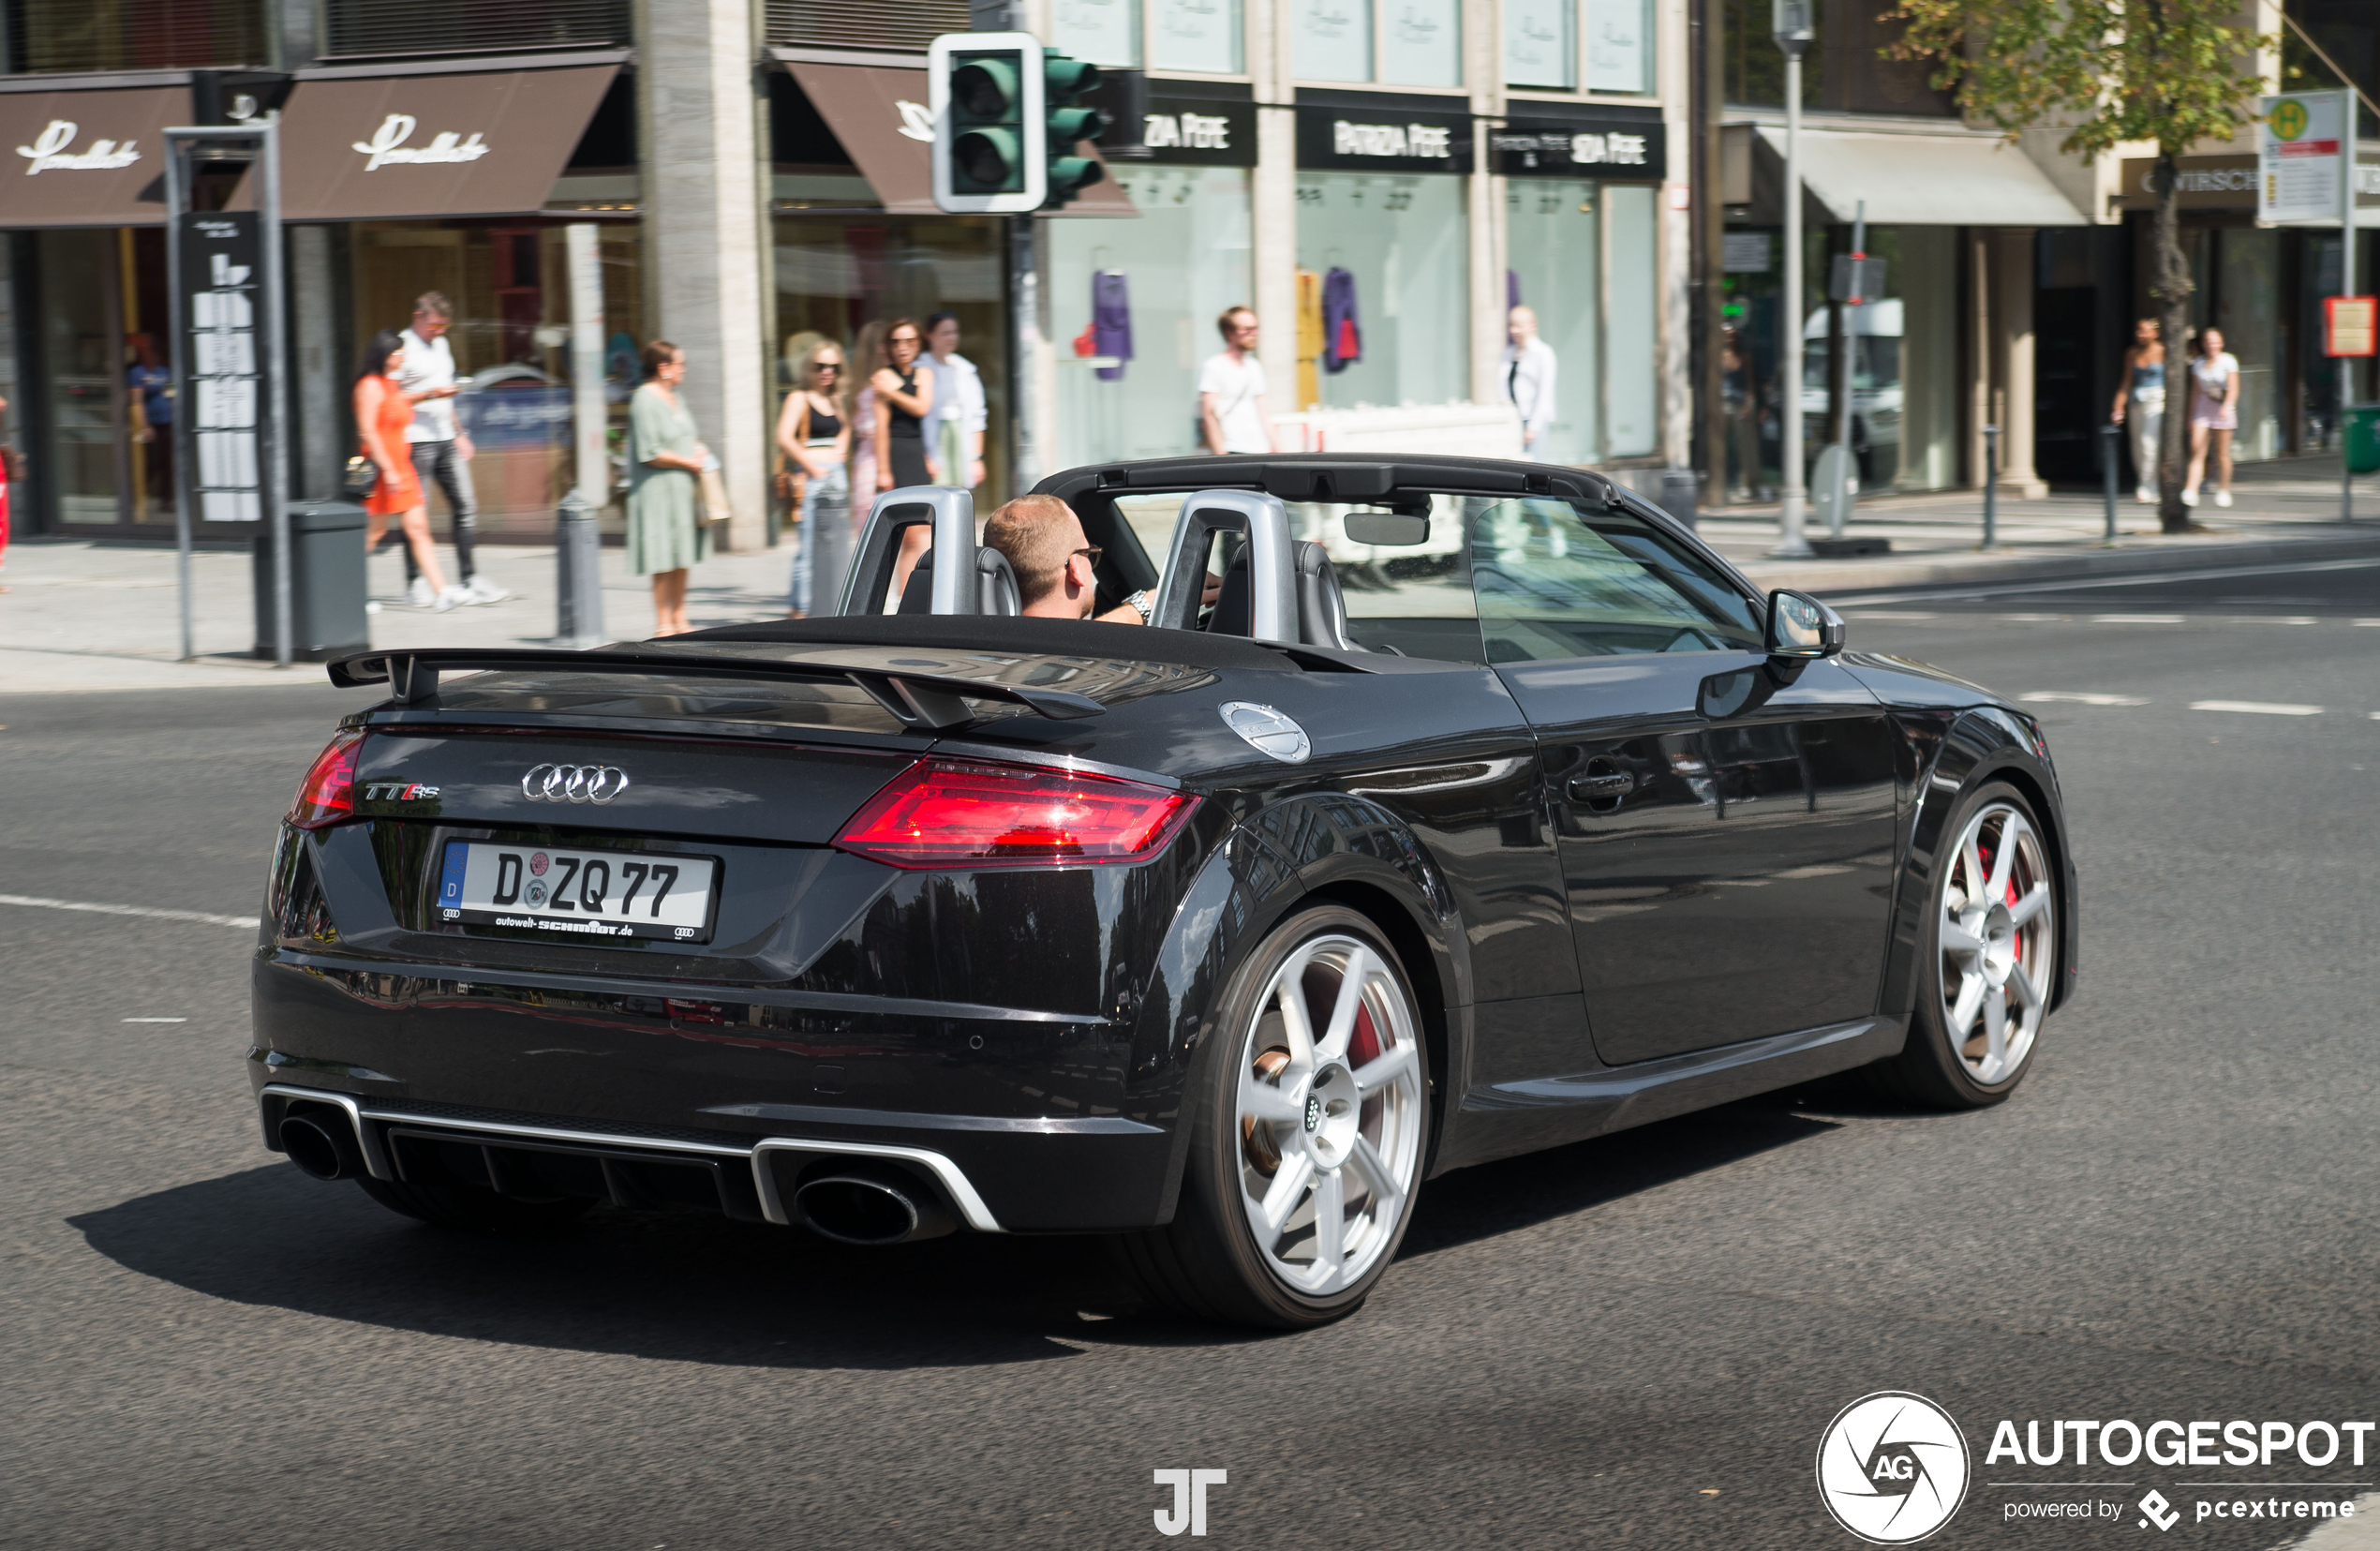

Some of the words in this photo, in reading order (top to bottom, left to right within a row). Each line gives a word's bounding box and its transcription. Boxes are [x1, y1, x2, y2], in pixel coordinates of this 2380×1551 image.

[447, 883, 456, 898] D
[492, 853, 524, 906] D
[549, 857, 611, 914] ZQ
[620, 861, 679, 917] 77
